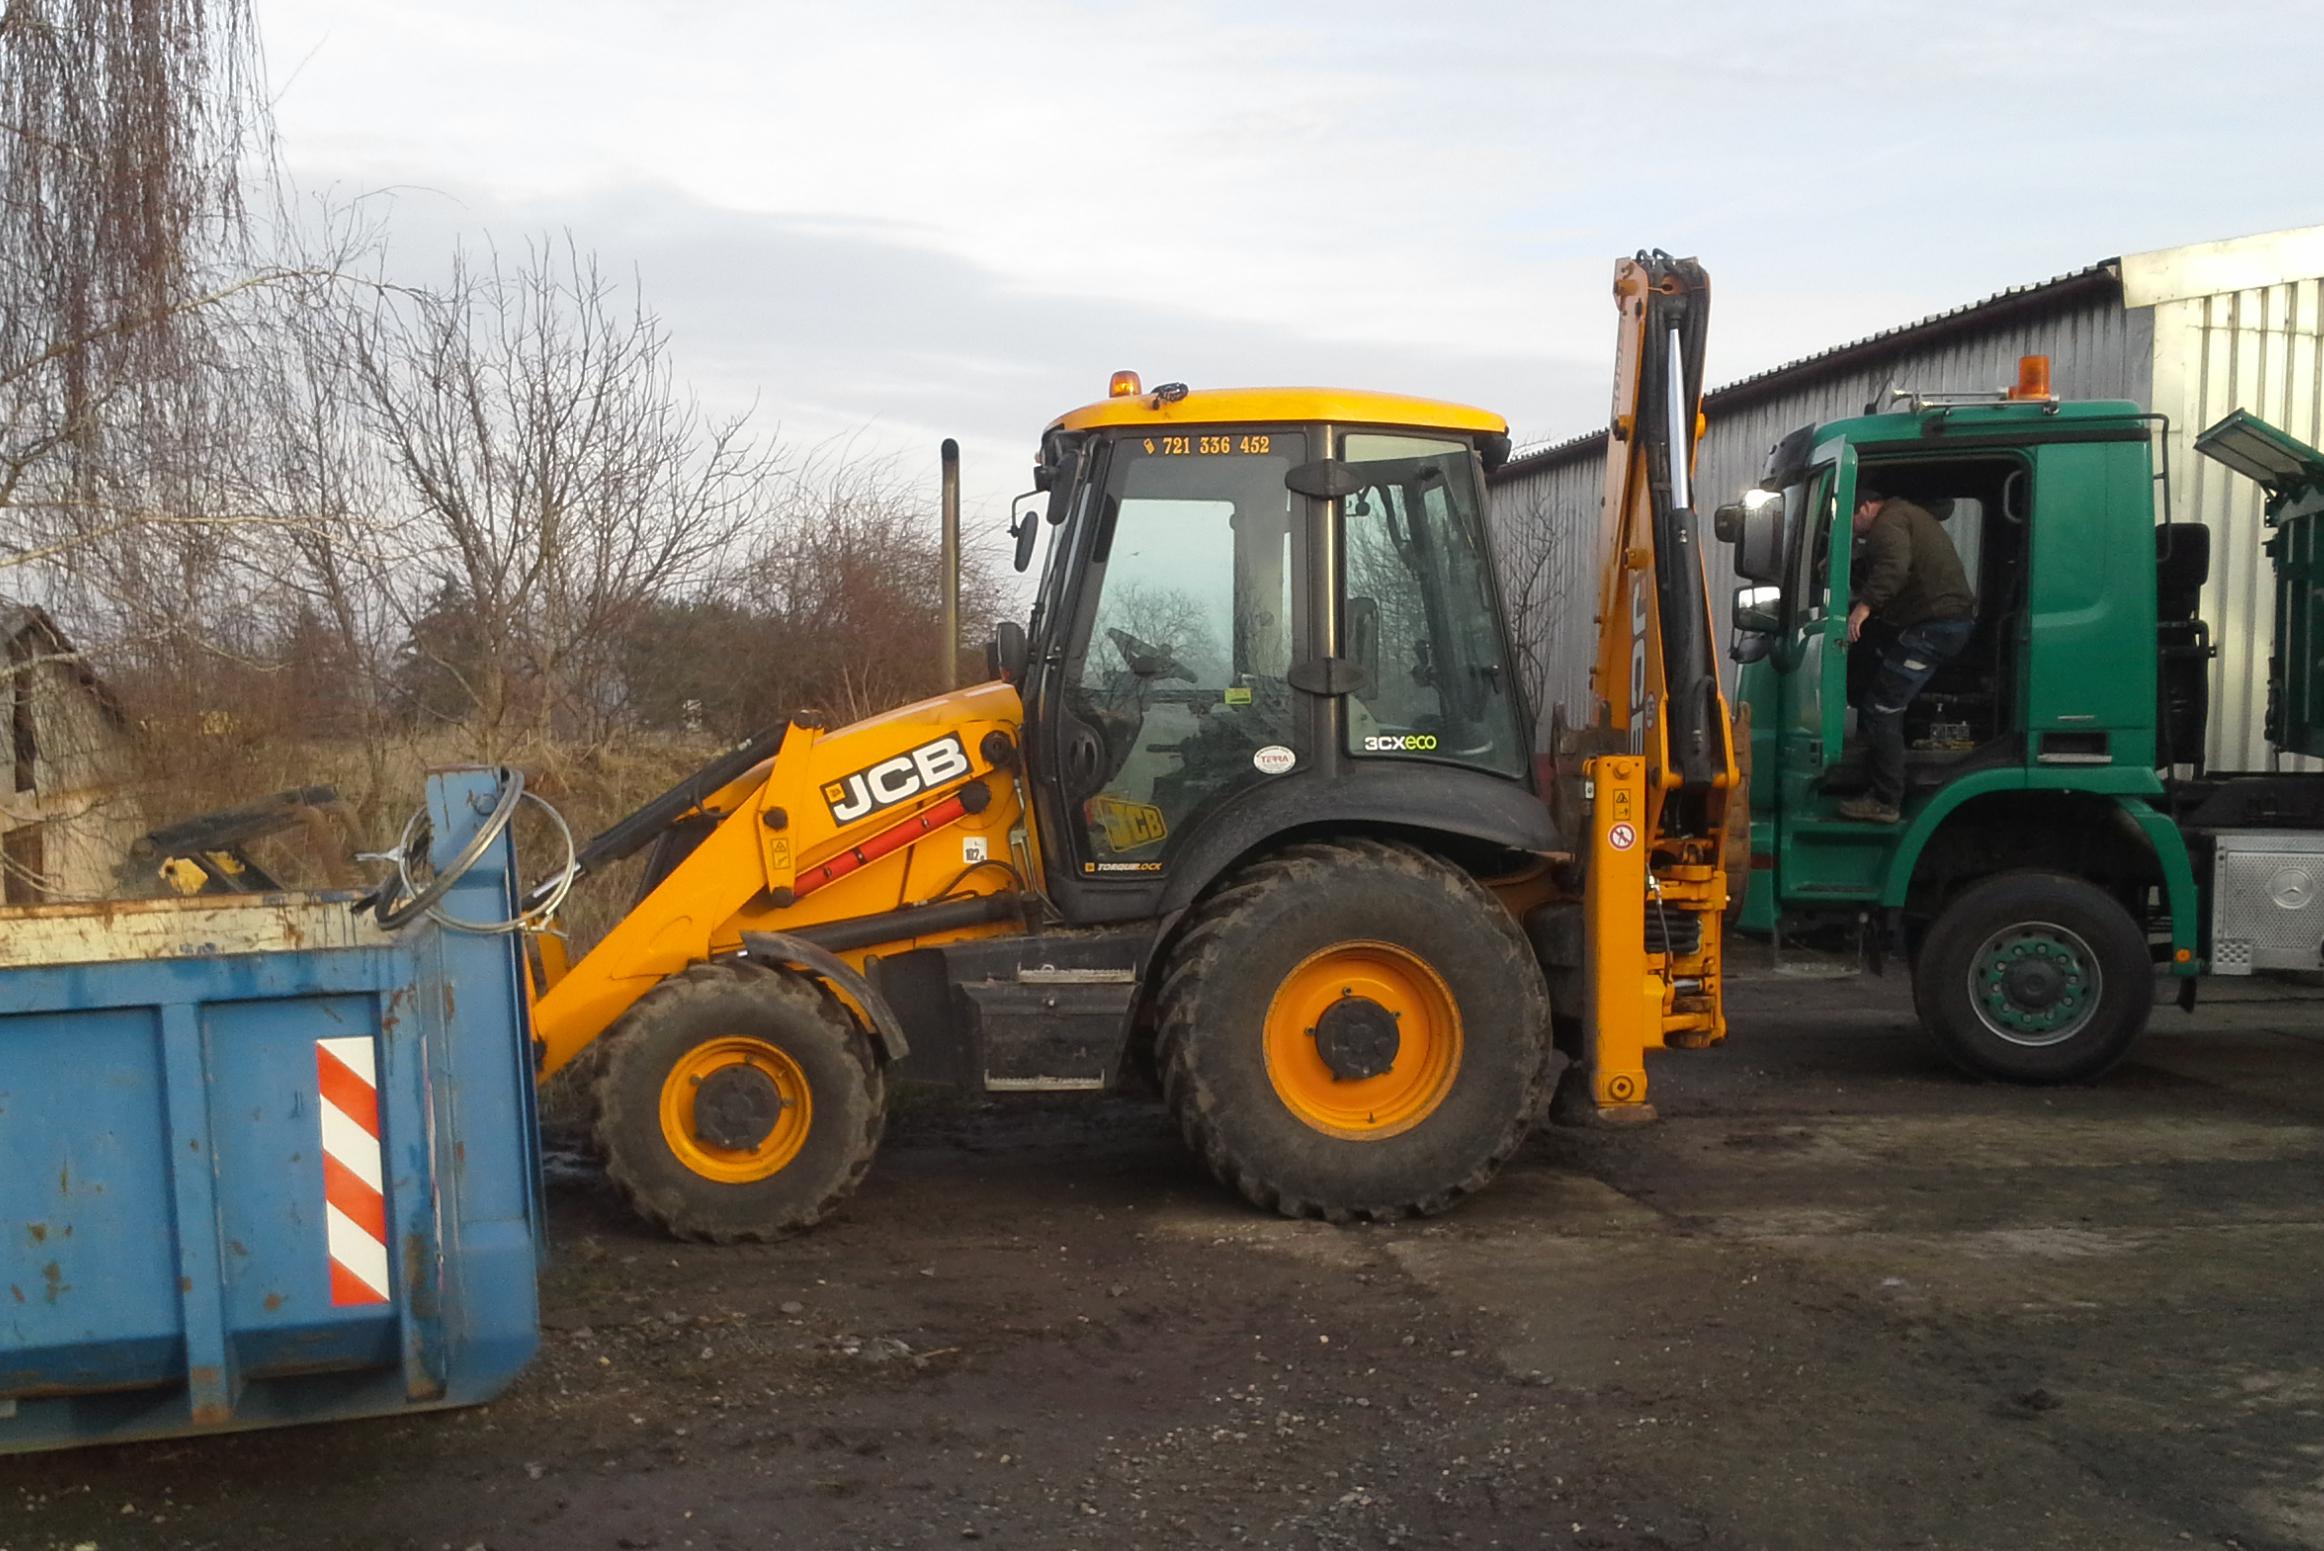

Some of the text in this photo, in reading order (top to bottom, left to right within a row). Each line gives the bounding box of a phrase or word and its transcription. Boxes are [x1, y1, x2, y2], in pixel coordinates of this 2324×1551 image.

[1162, 436, 1270, 455] 721 336 452
[1260, 754, 1289, 763] TERRA
[833, 738, 967, 820] JCB
